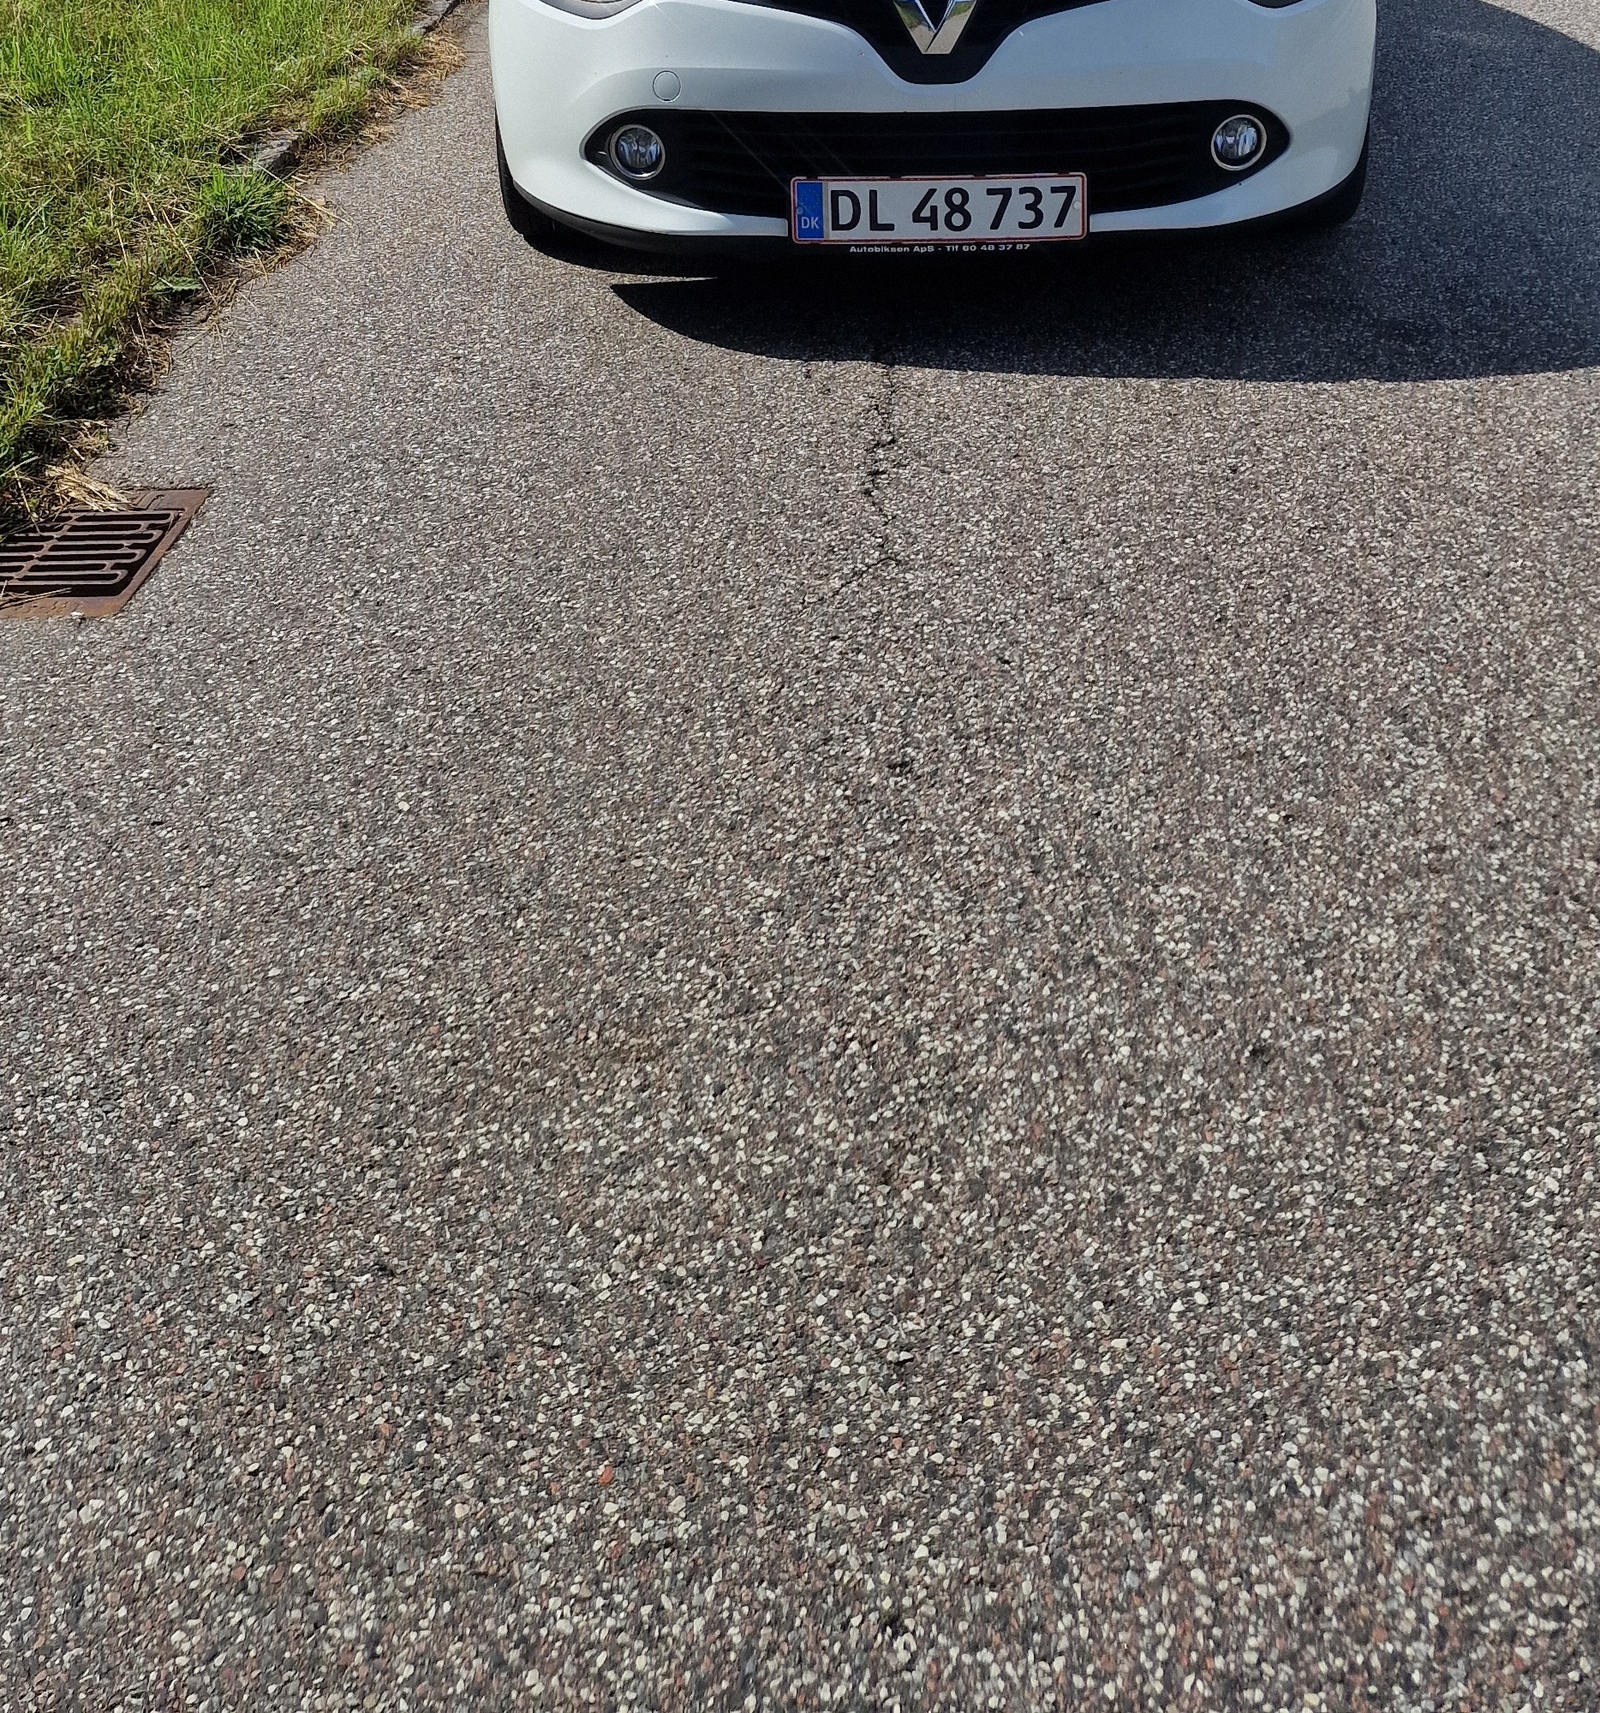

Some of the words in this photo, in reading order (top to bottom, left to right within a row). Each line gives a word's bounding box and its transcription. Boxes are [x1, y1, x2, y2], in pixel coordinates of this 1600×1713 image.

[830, 189, 895, 231] DL
[912, 187, 972, 231] 48
[986, 186, 1077, 230] 737
[801, 216, 820, 229] DK
[912, 245, 935, 253] ApS
